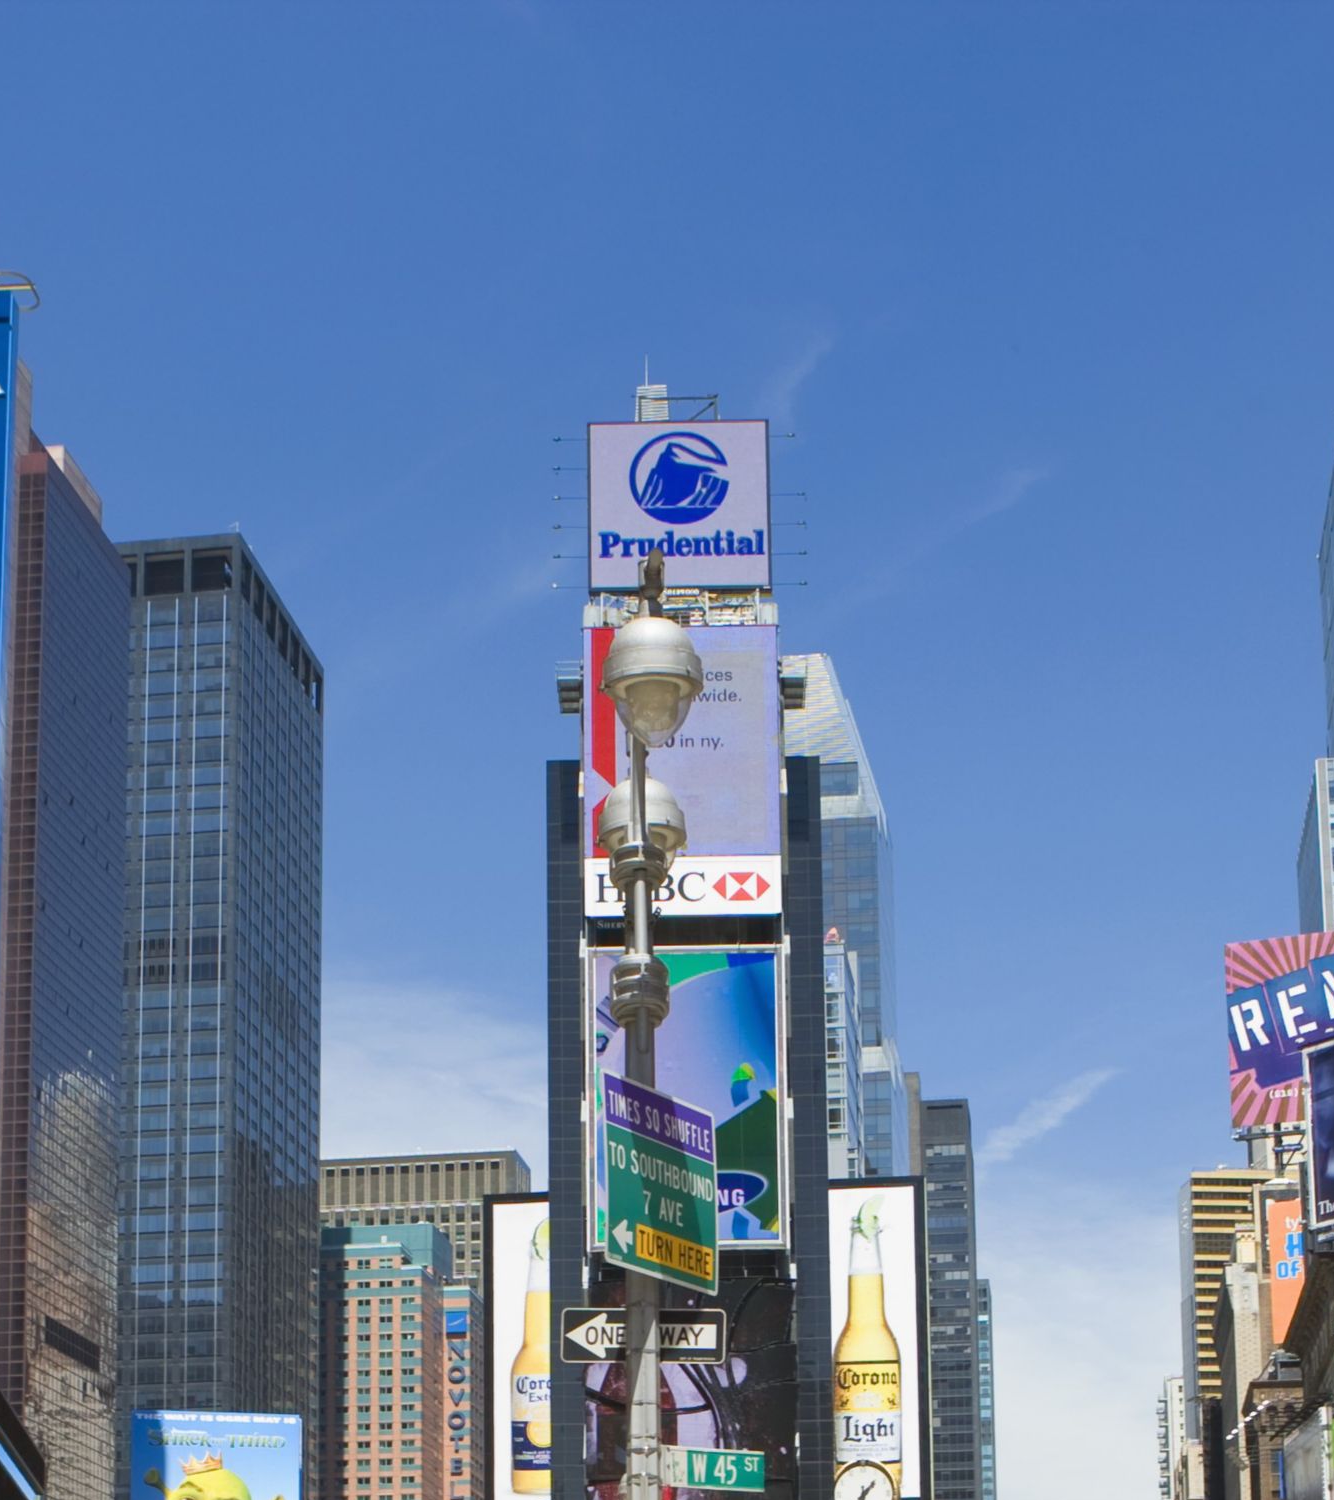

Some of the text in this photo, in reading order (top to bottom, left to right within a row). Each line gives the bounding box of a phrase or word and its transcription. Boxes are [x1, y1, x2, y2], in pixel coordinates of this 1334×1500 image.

[598, 529, 766, 559] Prudential
[680, 734, 724, 751] in ny.
[596, 872, 706, 903] HBC
[608, 1089, 711, 1155] TIMES SQ SHUFFLE
[609, 1140, 714, 1202] TO SOUTHBOUND
[643, 1190, 684, 1228] 7 AVE
[638, 1229, 712, 1276] TURN HERE
[585, 1326, 705, 1347] ONE WAY
[837, 1367, 898, 1392] Corona
[163, 1413, 198, 1422] WAIT
[253, 1416, 281, 1424] MAY
[842, 1415, 895, 1443] Light
[148, 1427, 287, 1449] SHREK THIRD
[692, 1453, 760, 1485] W 45 ST
